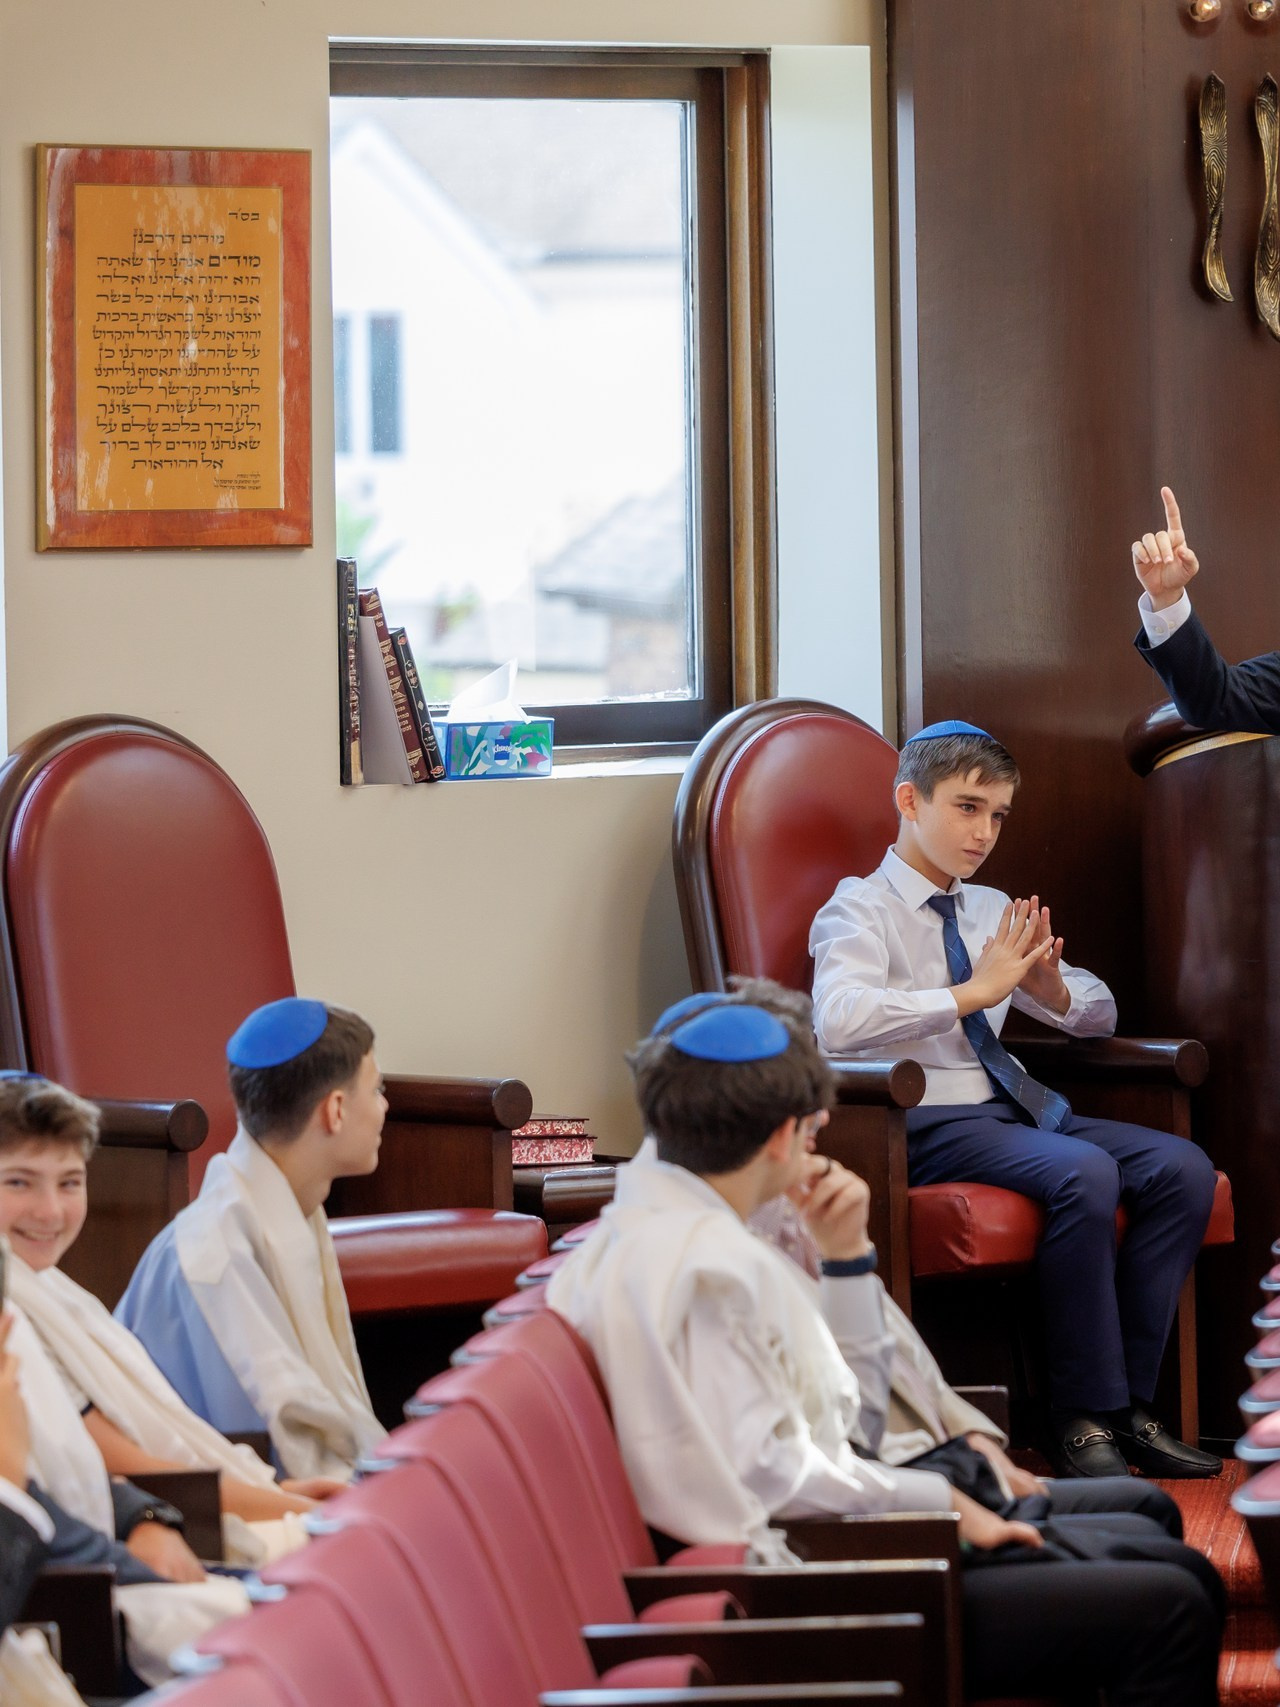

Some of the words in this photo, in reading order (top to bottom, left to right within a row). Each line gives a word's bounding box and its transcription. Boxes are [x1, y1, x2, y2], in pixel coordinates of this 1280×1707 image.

[132, 228, 176, 254] דרבנן
[181, 233, 225, 245] מודים
[96, 253, 144, 267] שאתה
[148, 250, 166, 272] לך
[208, 254, 261, 268] מודים
[96, 268, 145, 285] ואלהי
[198, 275, 229, 285] יהוה
[232, 275, 261, 285] הוא
[95, 290, 131, 304] בשר
[134, 287, 154, 304] כל
[157, 288, 199, 304] ואלהי
[203, 289, 260, 304] אבותינו
[95, 312, 139, 322] ברכות
[242, 342, 261, 359] על
[95, 416, 118, 434] על
[121, 416, 159, 433] שלם
[143, 434, 162, 455] לך
[165, 440, 207, 451] מודים
[201, 453, 224, 470] אל
